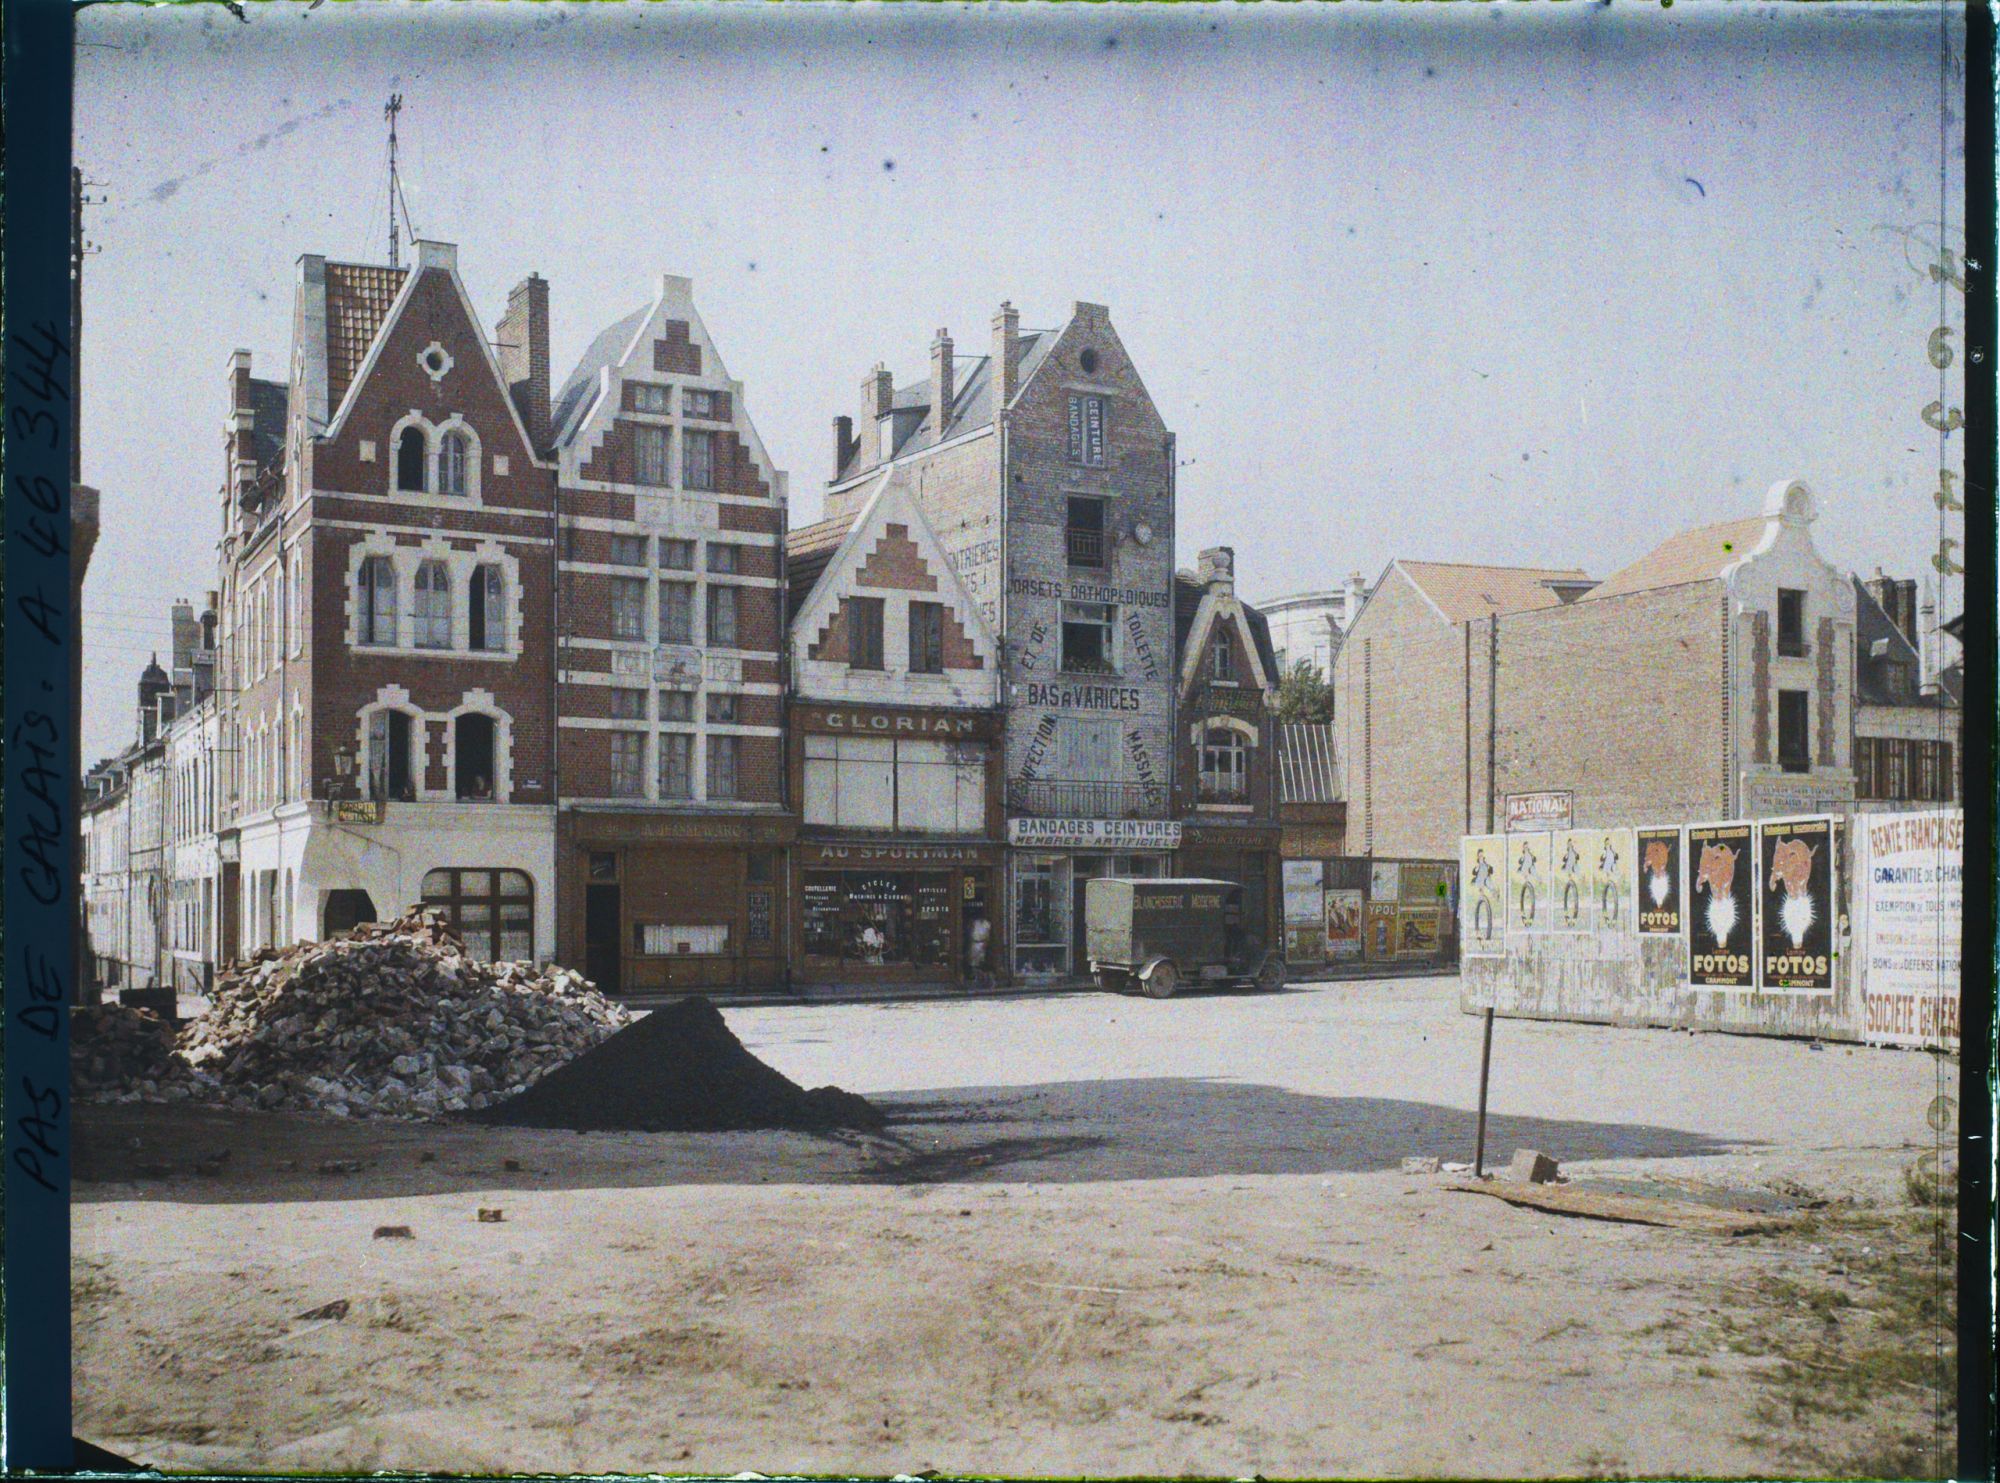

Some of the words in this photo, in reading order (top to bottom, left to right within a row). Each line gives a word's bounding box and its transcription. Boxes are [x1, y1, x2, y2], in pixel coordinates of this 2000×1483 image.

[1127, 611, 1160, 682] TOILETTE
[1028, 683, 1059, 706] BAS
[1073, 685, 1140, 710] VARICES
[1018, 819, 1094, 835] BANDAGES
[1104, 820, 1181, 836] CEINTURES
[1015, 835, 1082, 845] MEMBRES
[1094, 837, 1180, 847] ARTIFICIELS
[1871, 822, 1902, 858] RENTE
[820, 846, 849, 858] AU
[860, 846, 978, 860] SPORTMAN
[1874, 867, 1923, 883] GARANTIE
[861, 879, 897, 891] CYCLES
[1876, 901, 1915, 912] EXEMPTION
[1640, 912, 1678, 926] FOTOS
[1693, 954, 1750, 974] FOTOS
[1766, 955, 1828, 976] FOTOS
[1873, 957, 1892, 969] BONS
